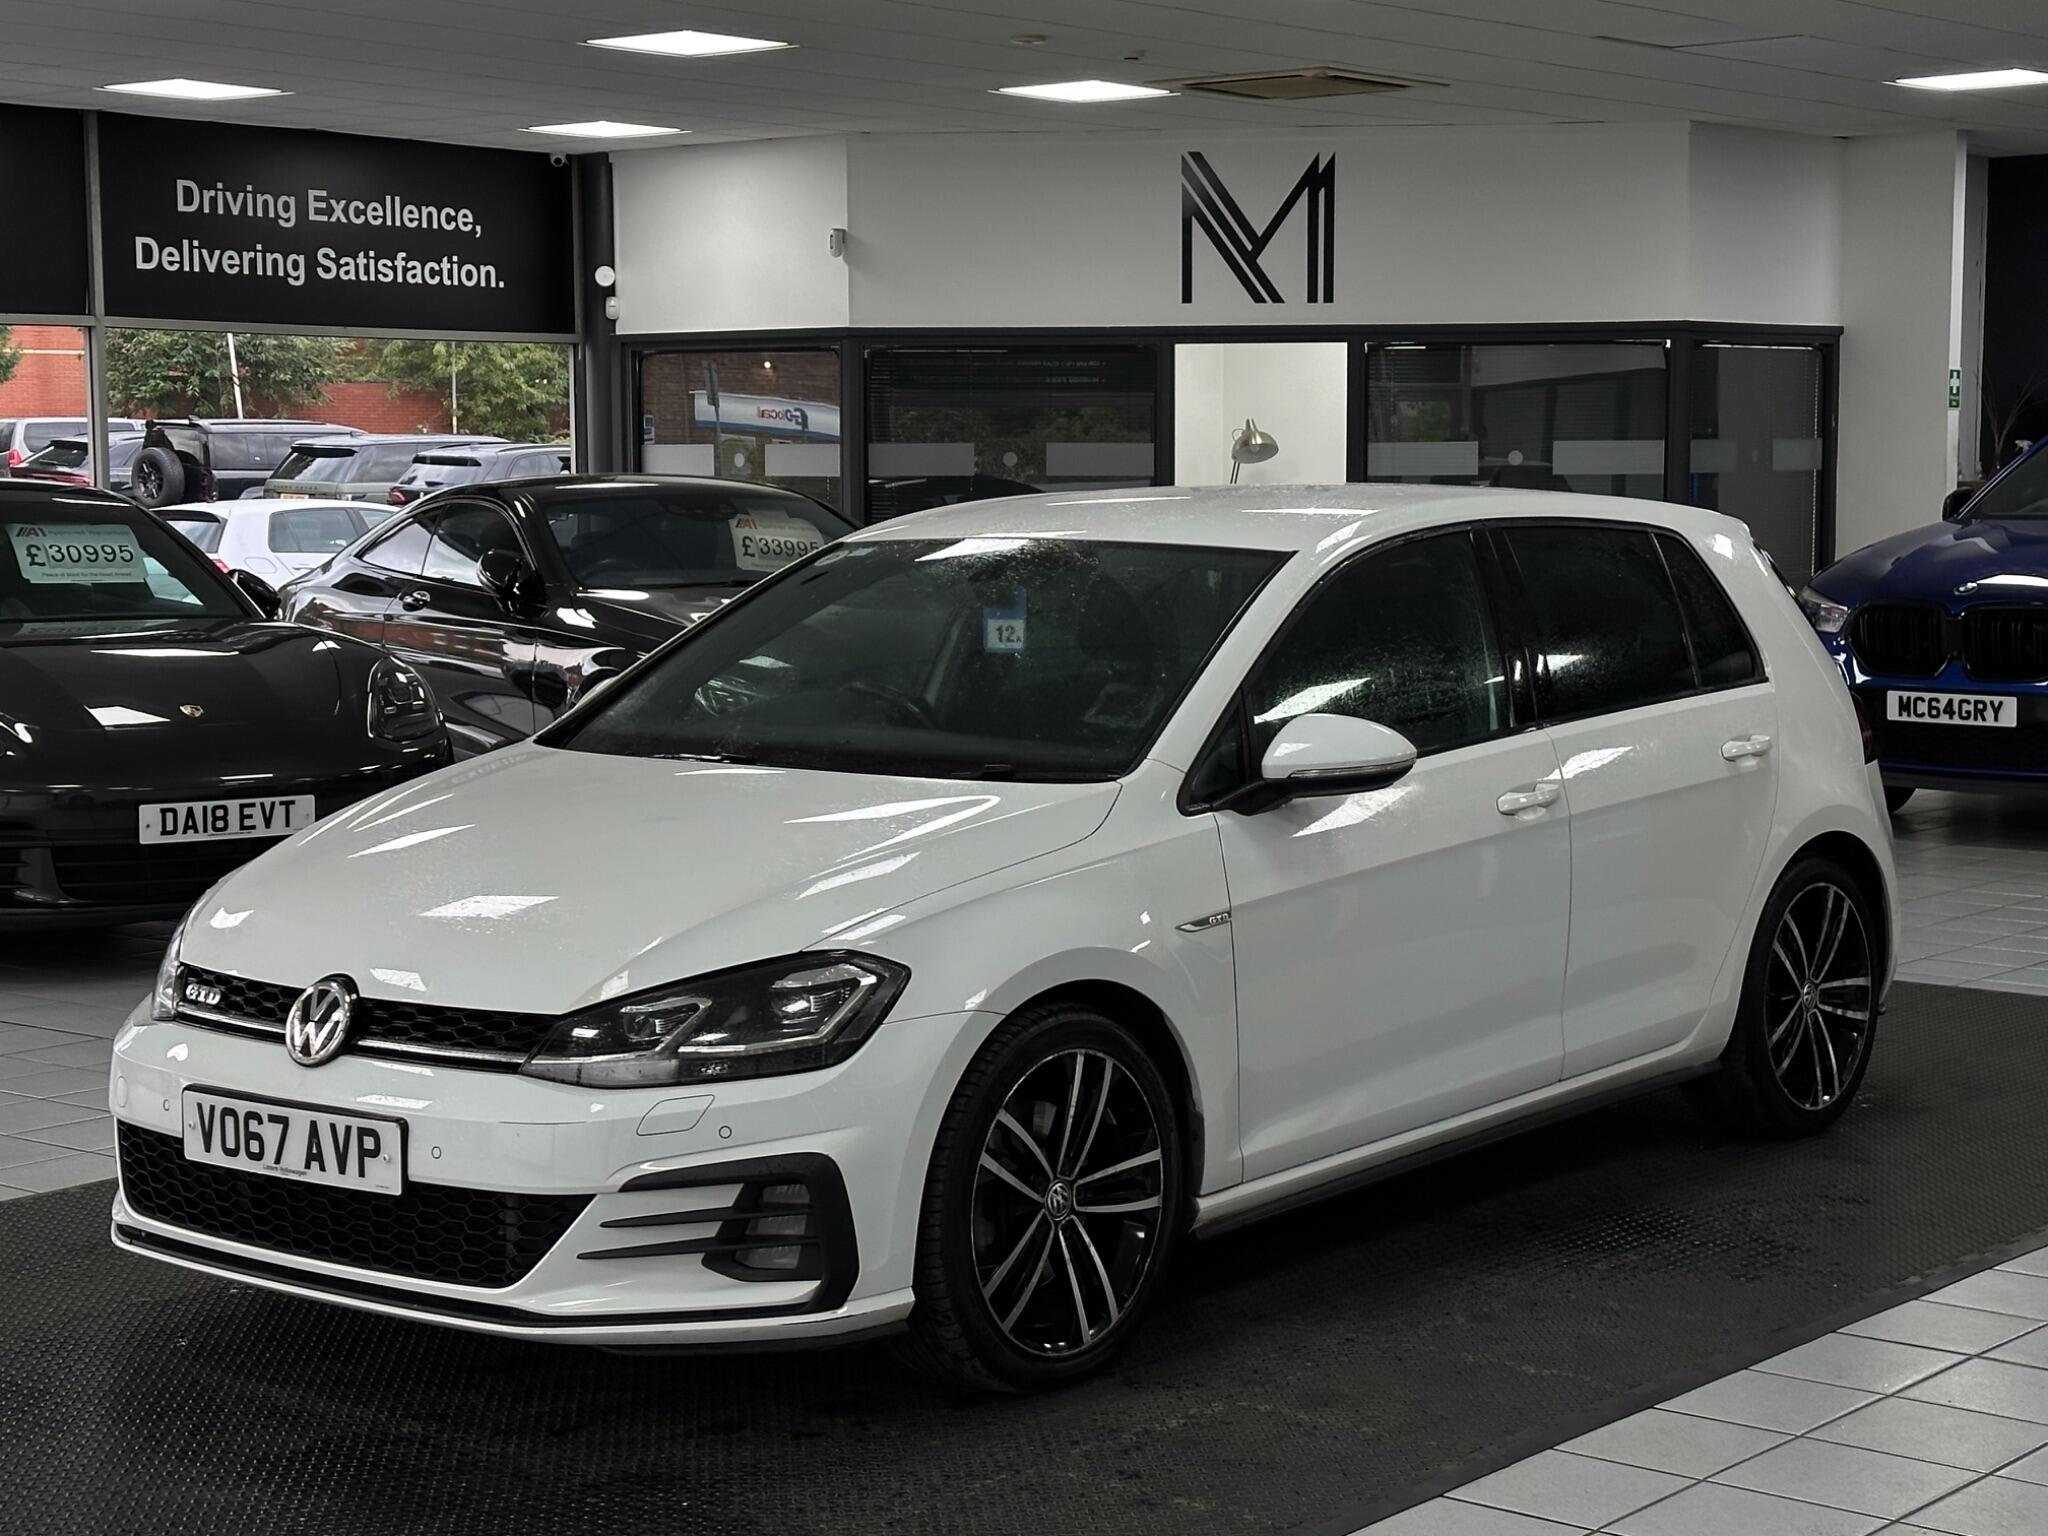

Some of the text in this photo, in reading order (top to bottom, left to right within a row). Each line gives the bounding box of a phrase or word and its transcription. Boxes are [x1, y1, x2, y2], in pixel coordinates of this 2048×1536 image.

[176, 179, 482, 238] Driving Excellence,
[135, 236, 505, 289] Delivering Satisfaction.
[26, 544, 134, 566] £30995
[1898, 695, 2004, 722] MC64GRY
[160, 800, 296, 836] DA18 EVT
[196, 1102, 382, 1178] VO67 AVP
